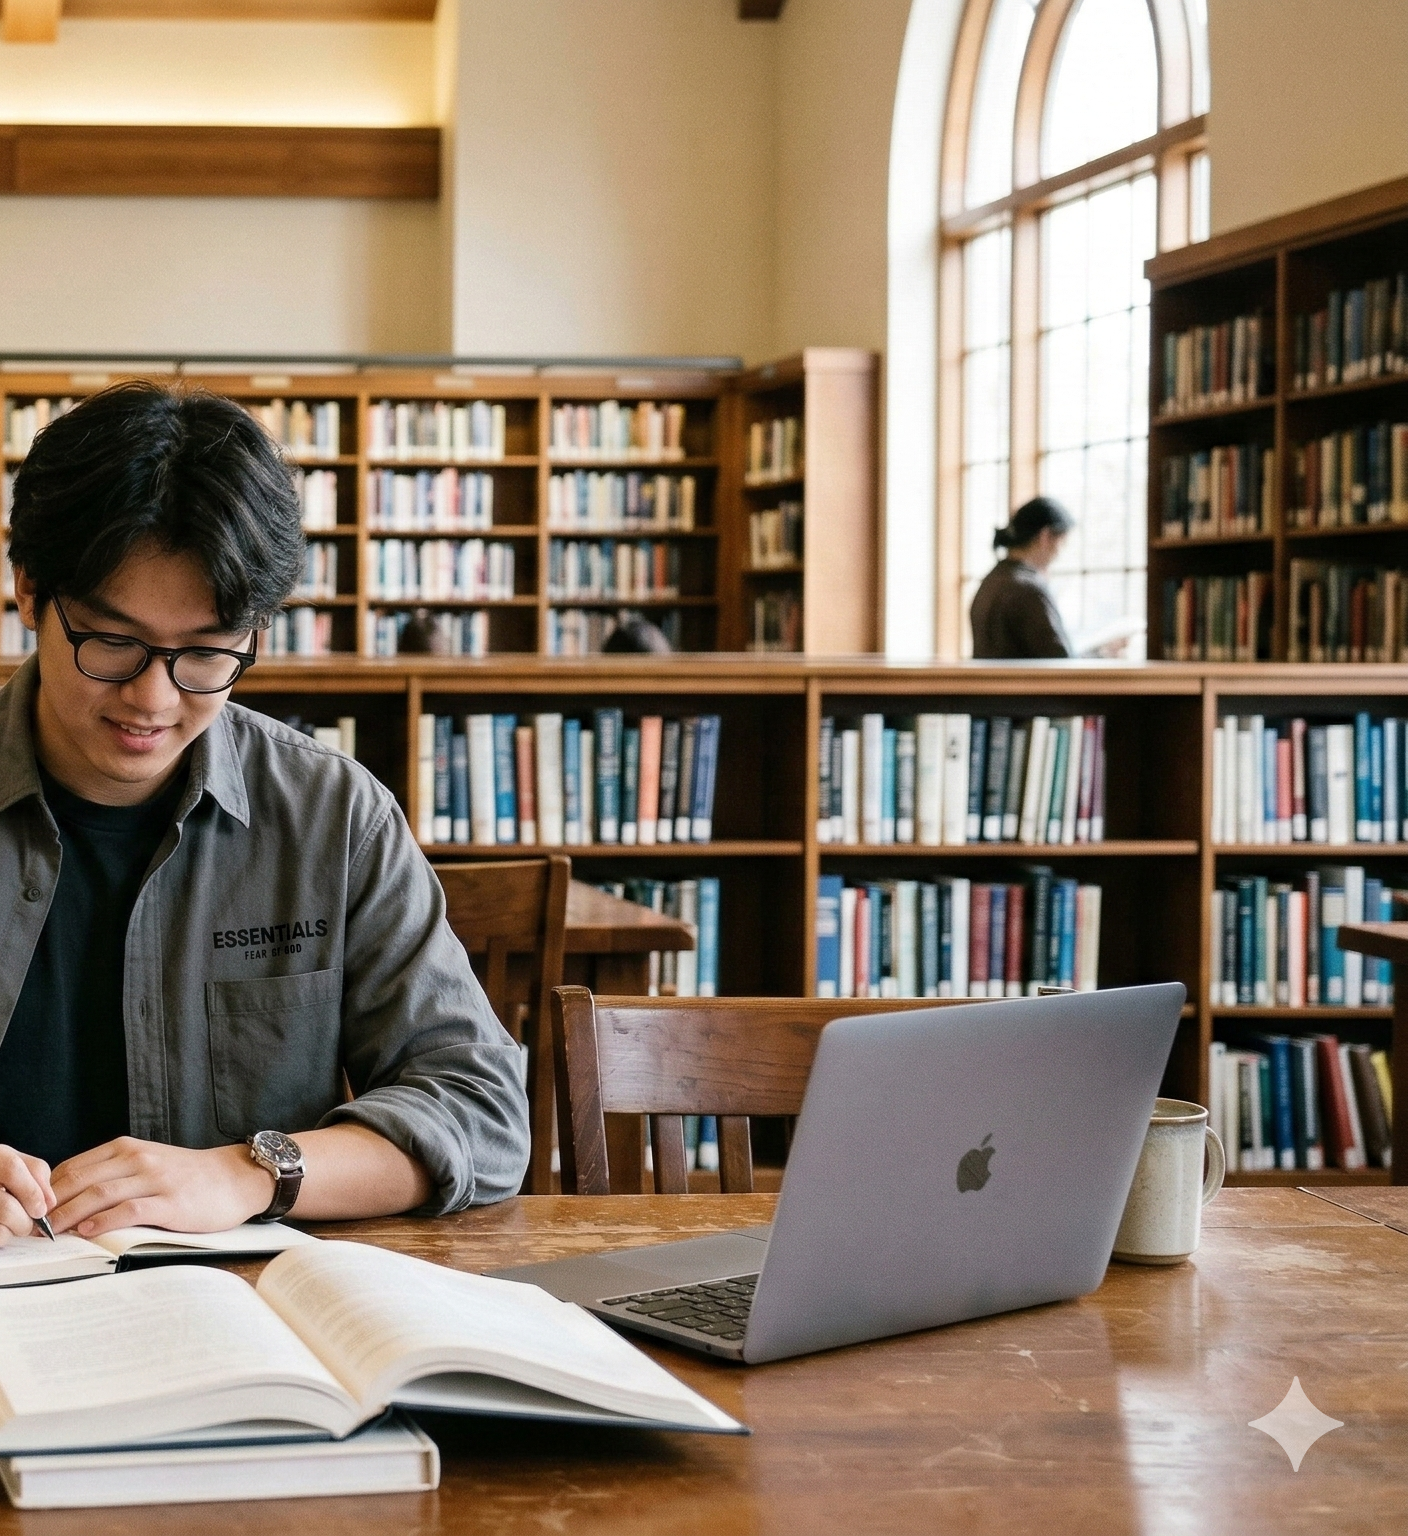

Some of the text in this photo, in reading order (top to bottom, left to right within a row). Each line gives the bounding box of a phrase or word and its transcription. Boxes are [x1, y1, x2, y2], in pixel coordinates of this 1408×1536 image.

[212, 918, 328, 949] ESSENTIALS
[244, 950, 267, 960] FEAR
[284, 943, 302, 955] GOD
